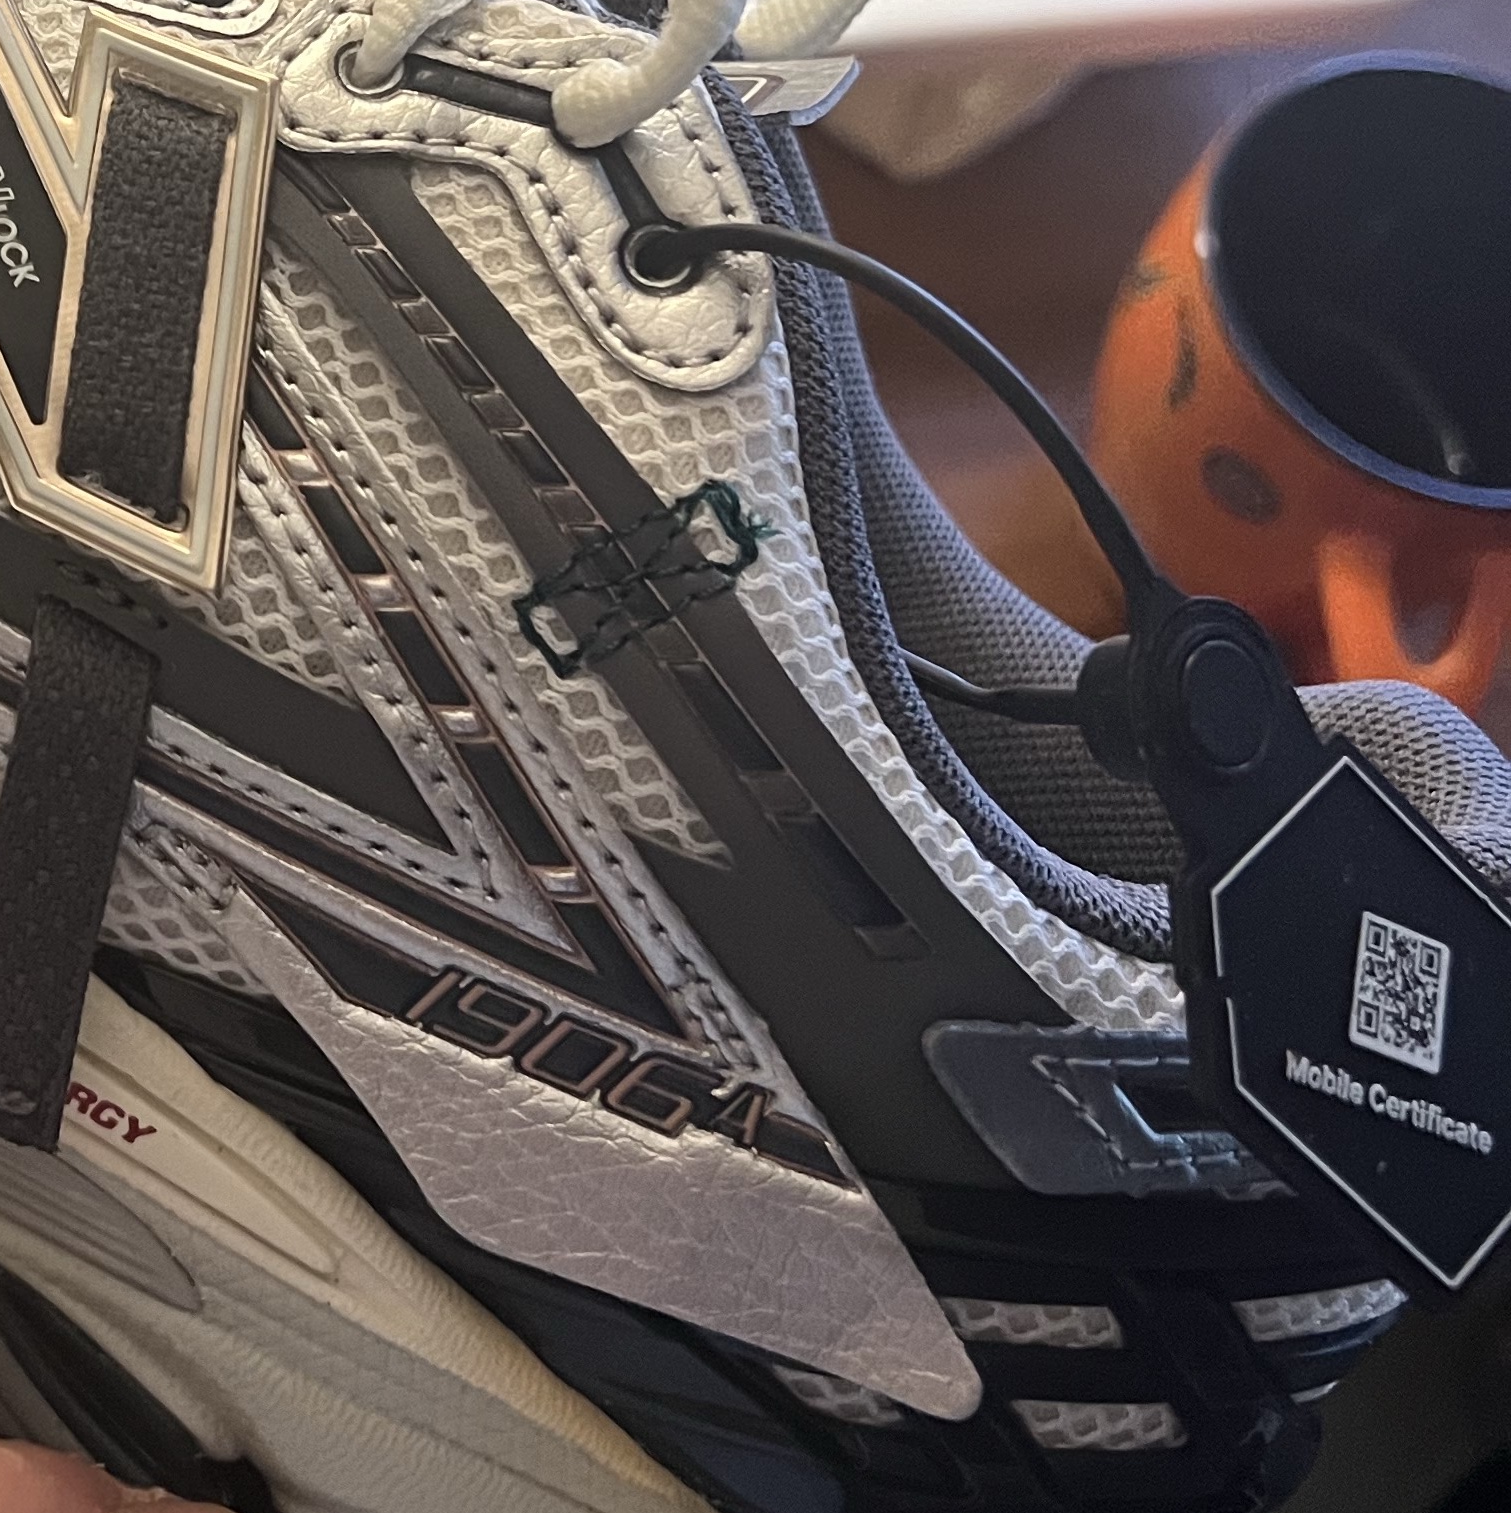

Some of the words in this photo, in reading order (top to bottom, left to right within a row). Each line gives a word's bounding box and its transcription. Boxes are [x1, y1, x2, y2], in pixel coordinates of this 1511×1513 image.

[64, 1080, 158, 1144] RGY
[1285, 1049, 1364, 1105] Mobile
[1368, 1083, 1493, 1156] Certificate
